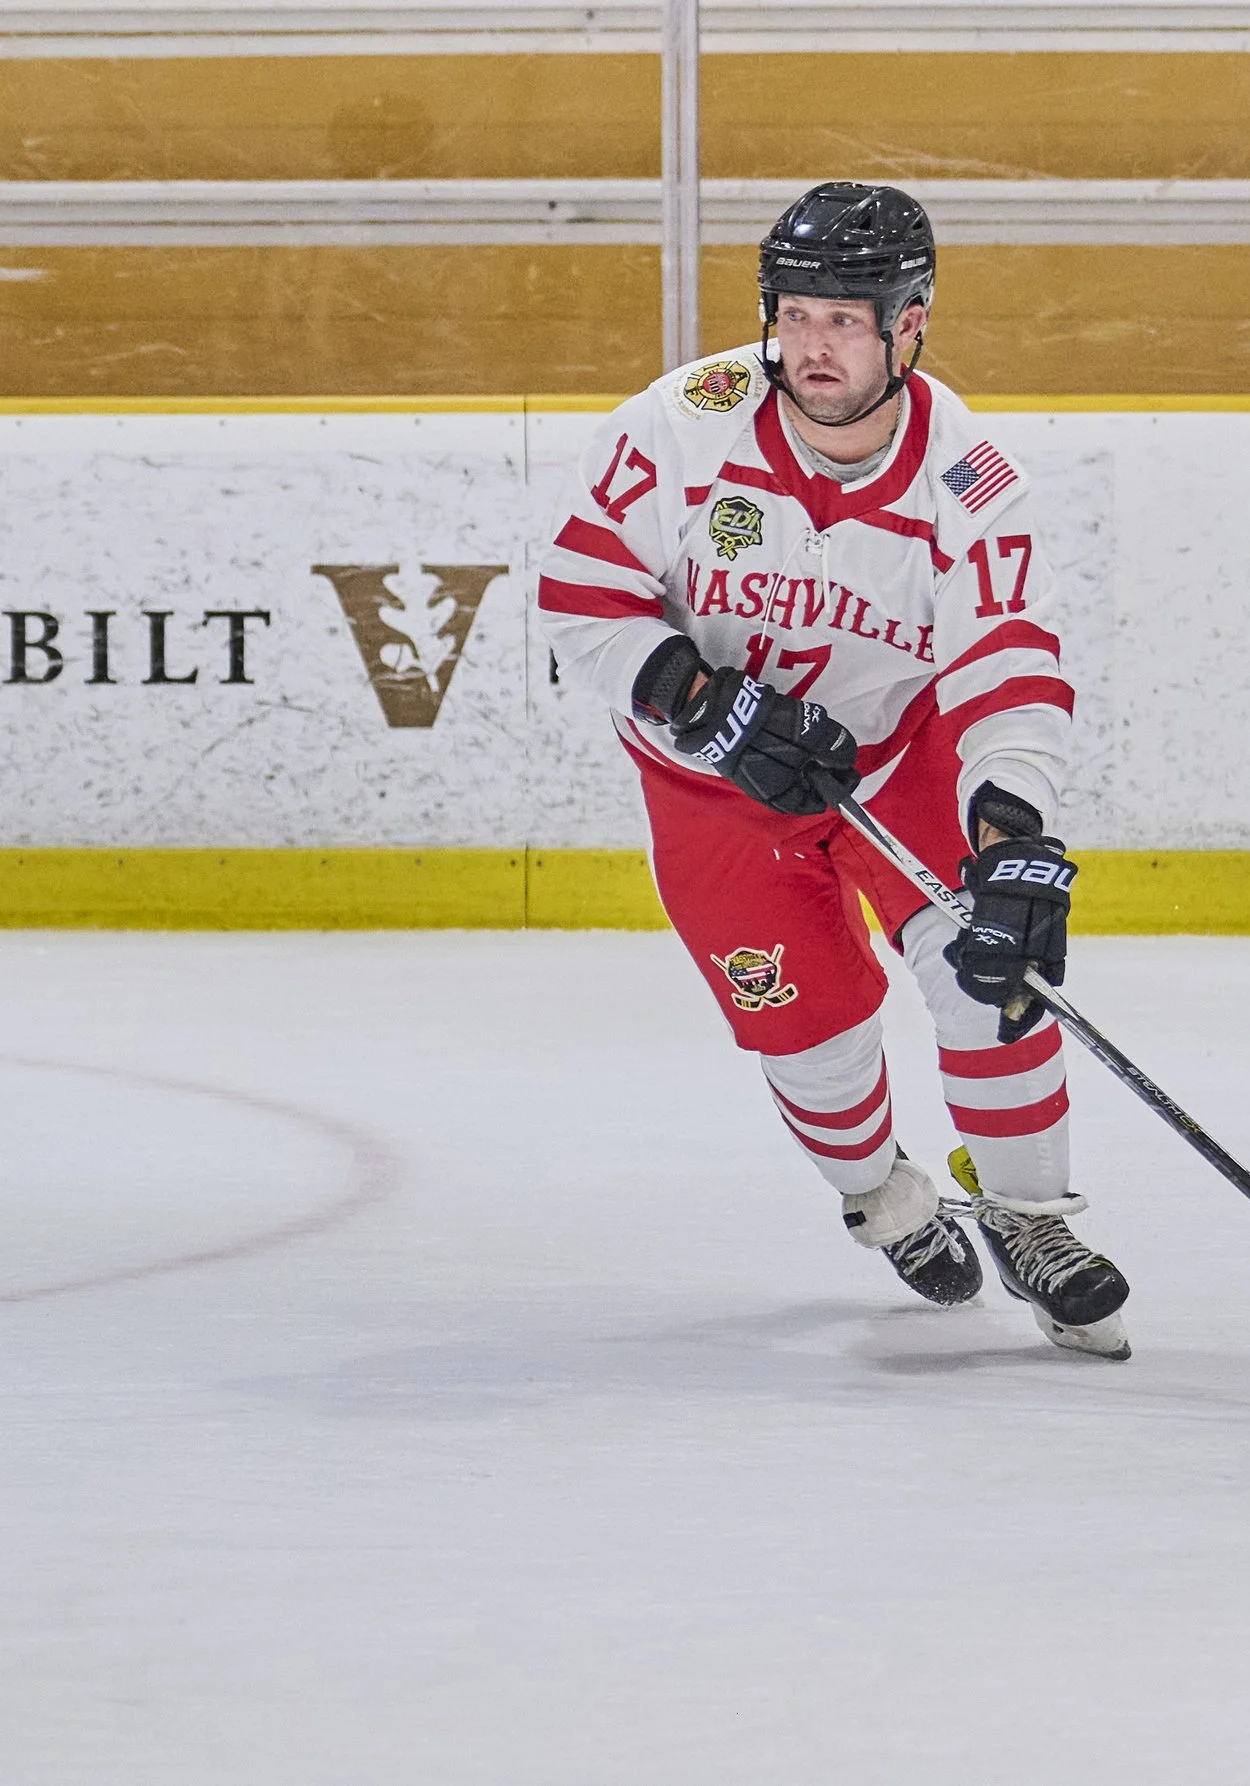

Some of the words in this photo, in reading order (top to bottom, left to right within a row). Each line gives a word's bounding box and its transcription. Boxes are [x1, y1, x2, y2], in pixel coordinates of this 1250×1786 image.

[776, 257, 821, 269] BAUER
[590, 432, 657, 525] 17
[967, 534, 1032, 618] 17
[2, 611, 270, 684] BILT
[800, 701, 811, 735] VAPO
[971, 925, 1016, 945] VAPOR
[1126, 1066, 1182, 1116] STEALTH
